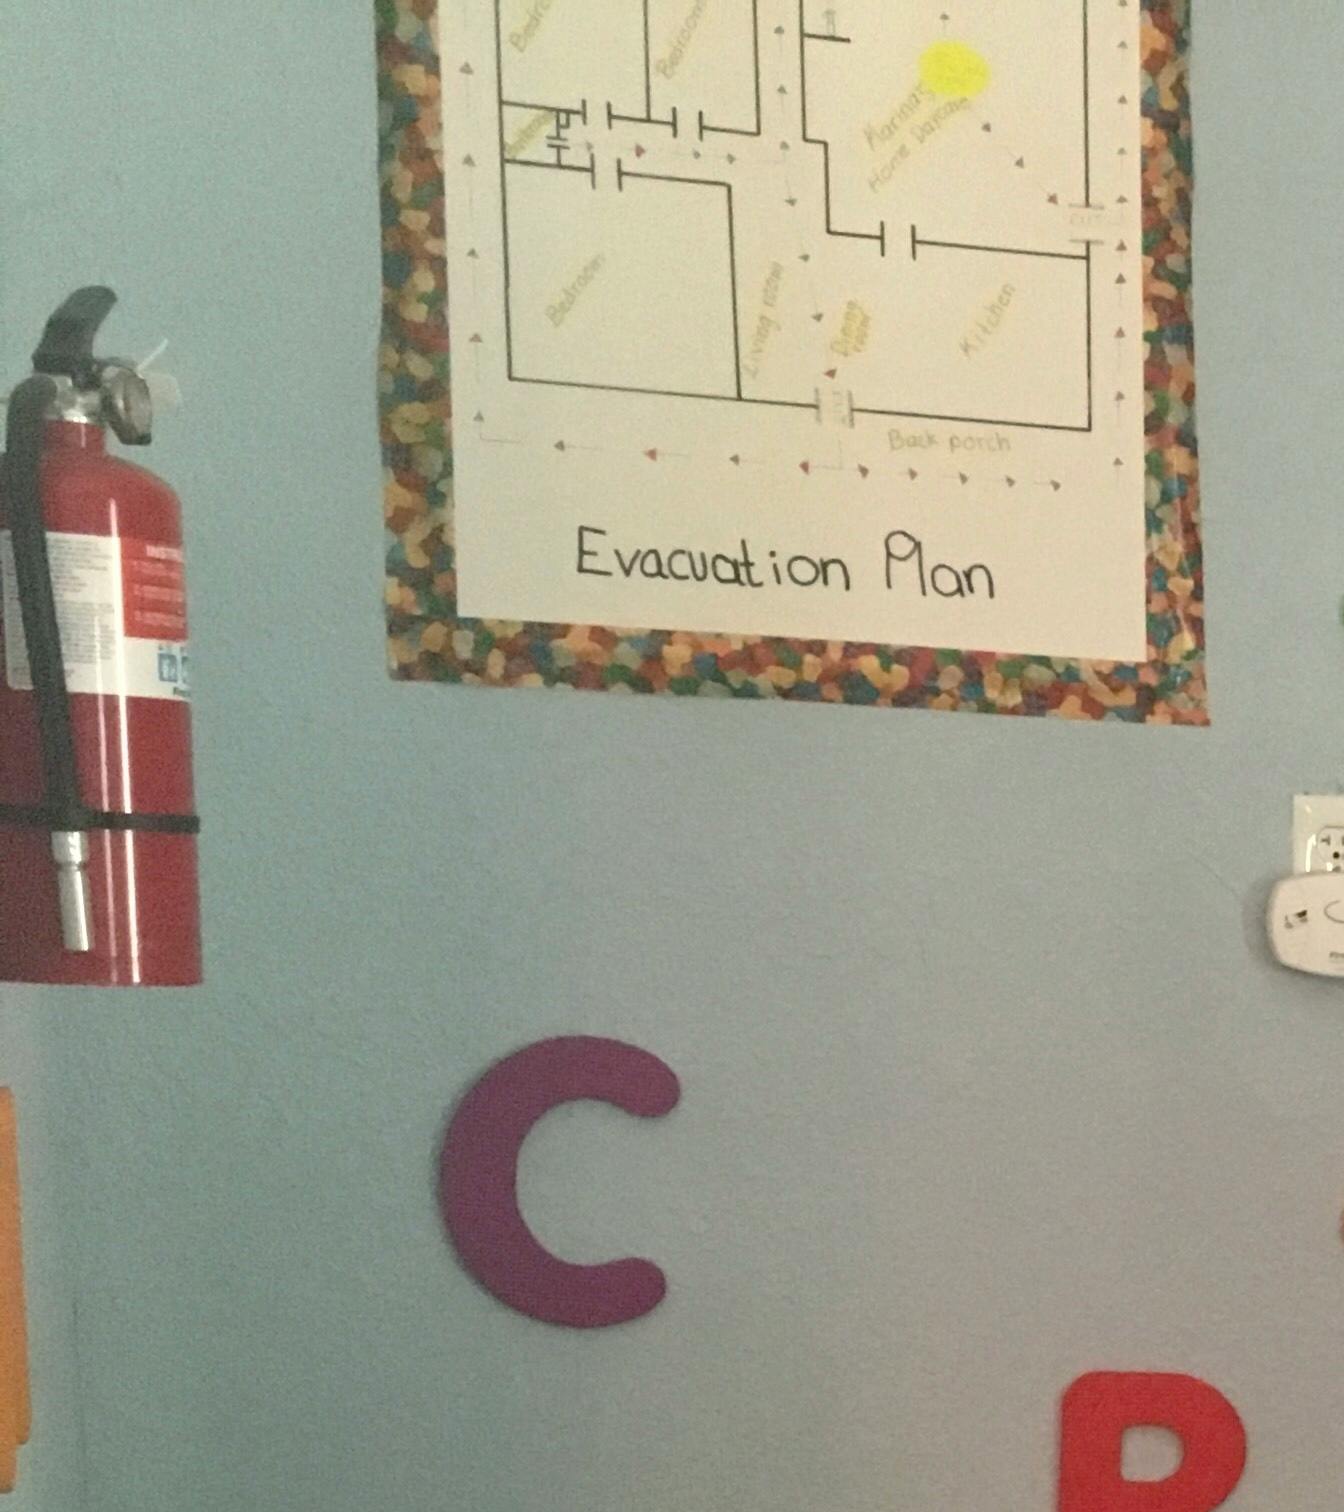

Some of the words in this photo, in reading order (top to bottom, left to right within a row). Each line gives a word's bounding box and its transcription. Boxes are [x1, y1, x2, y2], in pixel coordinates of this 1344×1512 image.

[958, 281, 1017, 361] Kitchen
[886, 428, 940, 452] Back
[948, 430, 1013, 453] porch
[575, 524, 852, 592] Evacuation
[883, 529, 996, 599] Plan
[437, 1037, 681, 1327] C
